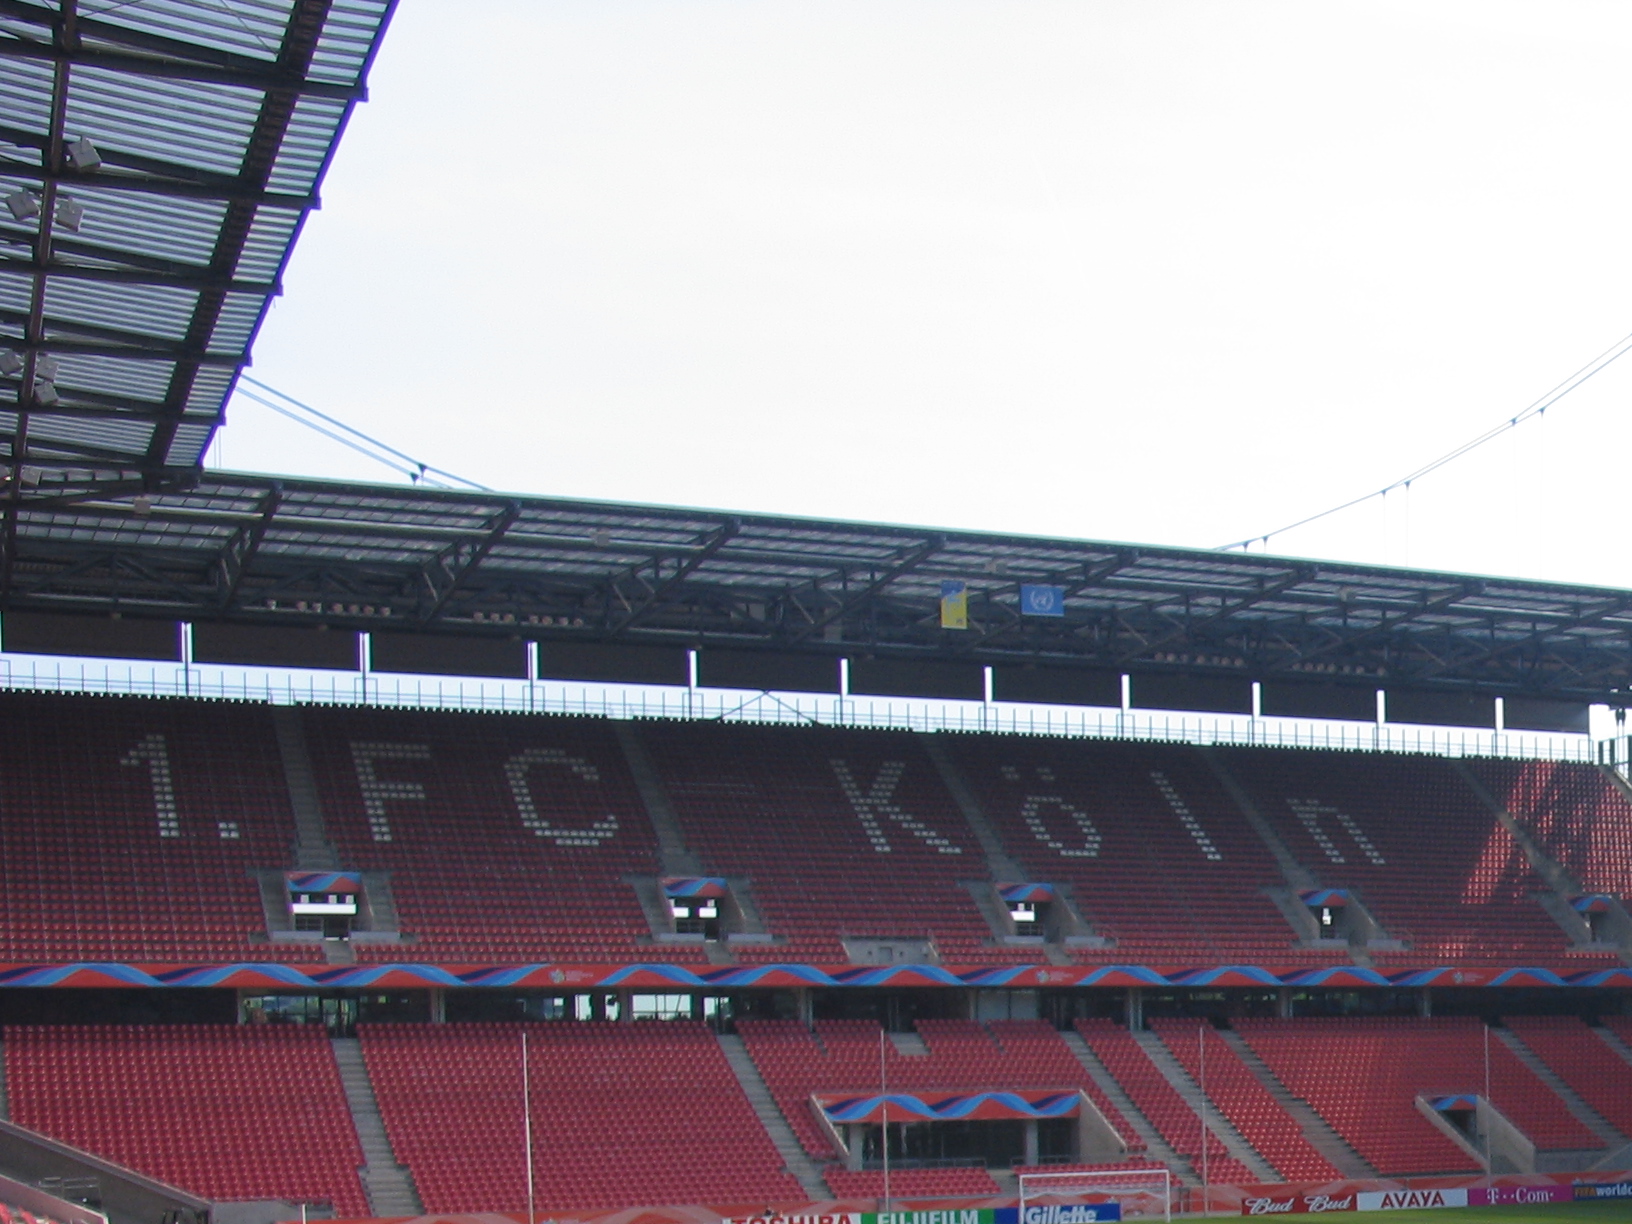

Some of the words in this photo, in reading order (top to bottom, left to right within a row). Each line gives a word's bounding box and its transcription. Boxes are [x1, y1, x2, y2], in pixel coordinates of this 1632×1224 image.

[350, 741, 619, 846] FC
[1244, 1197, 1295, 1215] Bud
[1303, 1194, 1352, 1213] Bud
[1380, 1190, 1446, 1209] AVAYA
